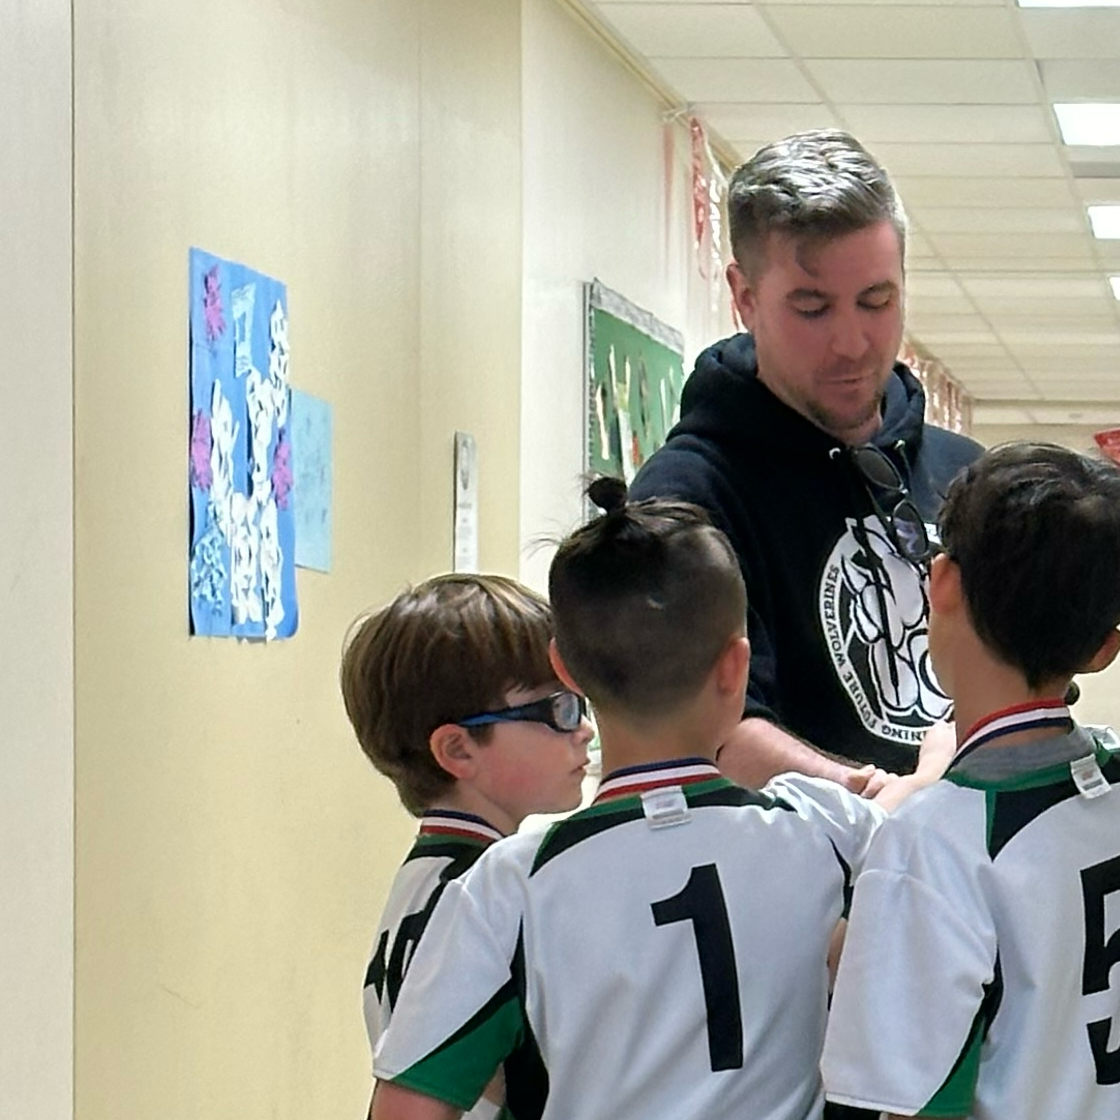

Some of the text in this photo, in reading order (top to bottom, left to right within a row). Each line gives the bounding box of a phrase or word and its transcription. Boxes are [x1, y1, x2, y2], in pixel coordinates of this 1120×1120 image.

[823, 565, 847, 668] WOLVERINES
[842, 672, 878, 730] FUTURE
[650, 863, 743, 1072] 1
